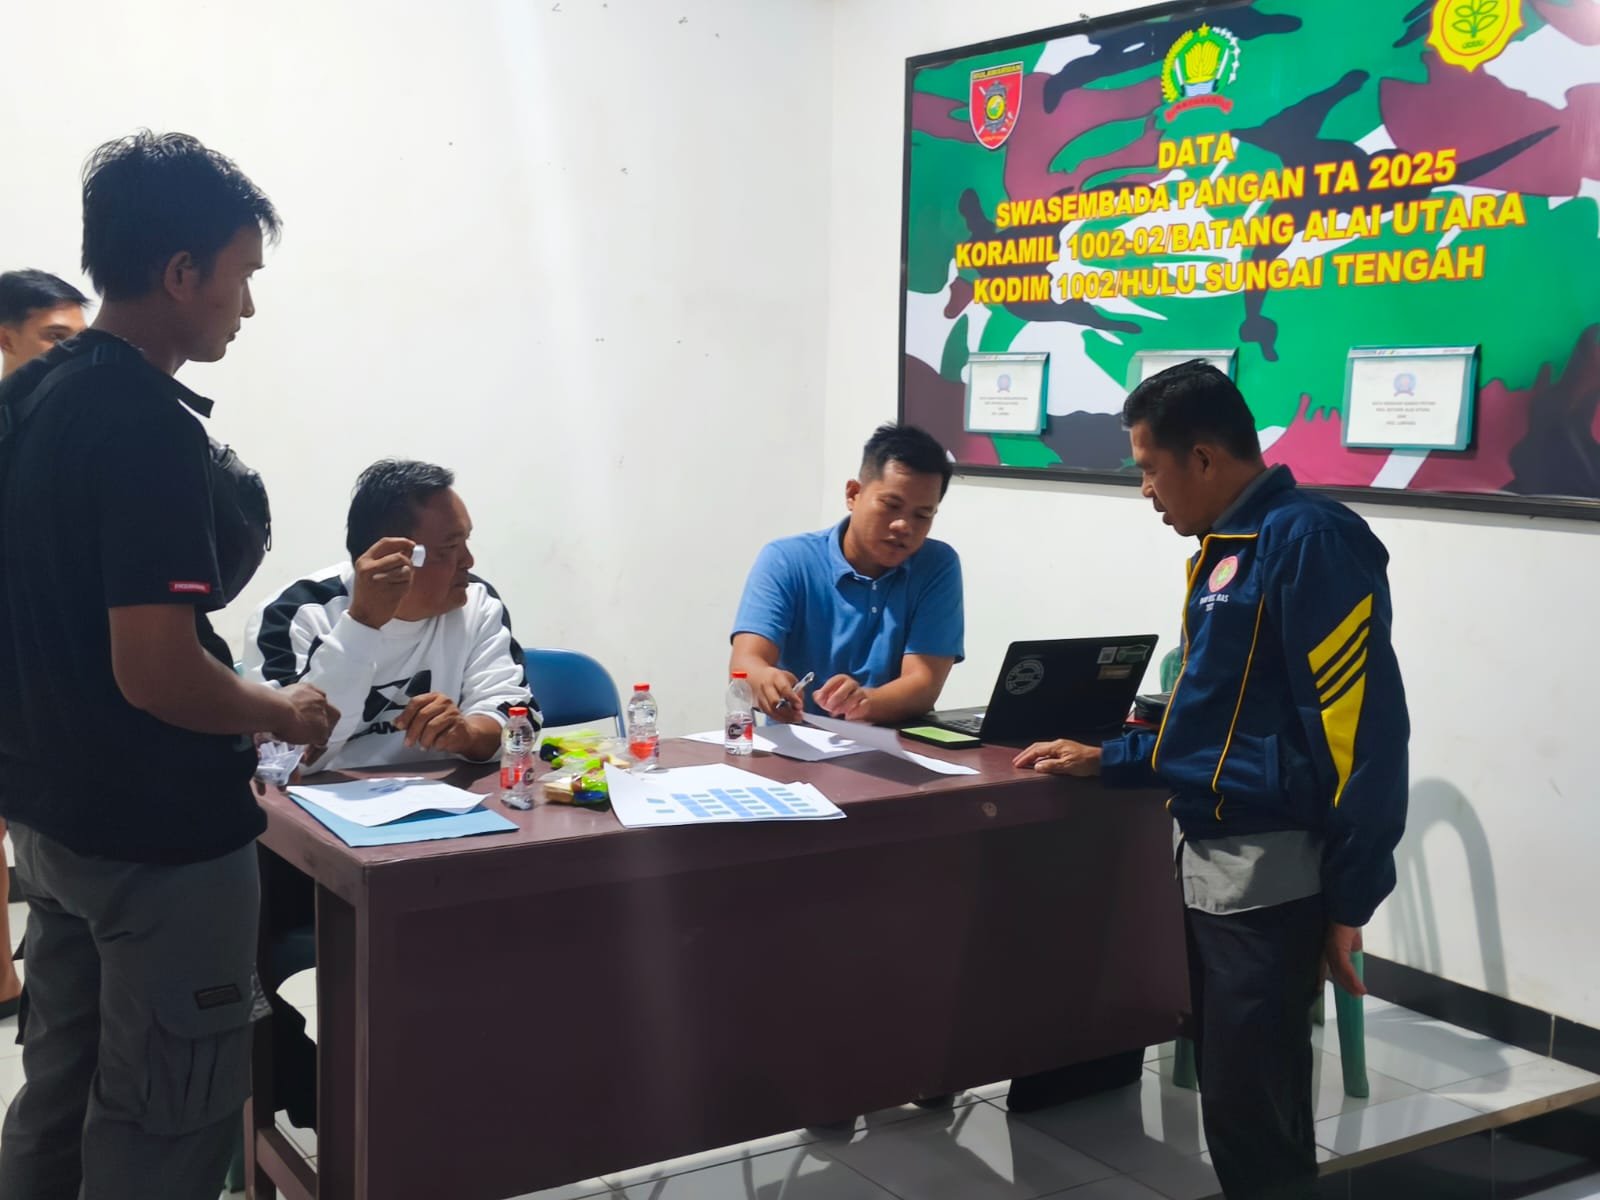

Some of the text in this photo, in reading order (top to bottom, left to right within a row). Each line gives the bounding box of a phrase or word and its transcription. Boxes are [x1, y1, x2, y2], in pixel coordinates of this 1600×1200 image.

[1157, 131, 1235, 170] DATA
[995, 148, 1457, 228] SWASEMBADA PANGAN TA 2025
[955, 191, 1526, 268] KORAMIL 1002-02/BATANG ALAI UTARA
[973, 244, 1485, 304] KODIM 1002/HULU SUNGAI TENGAH
